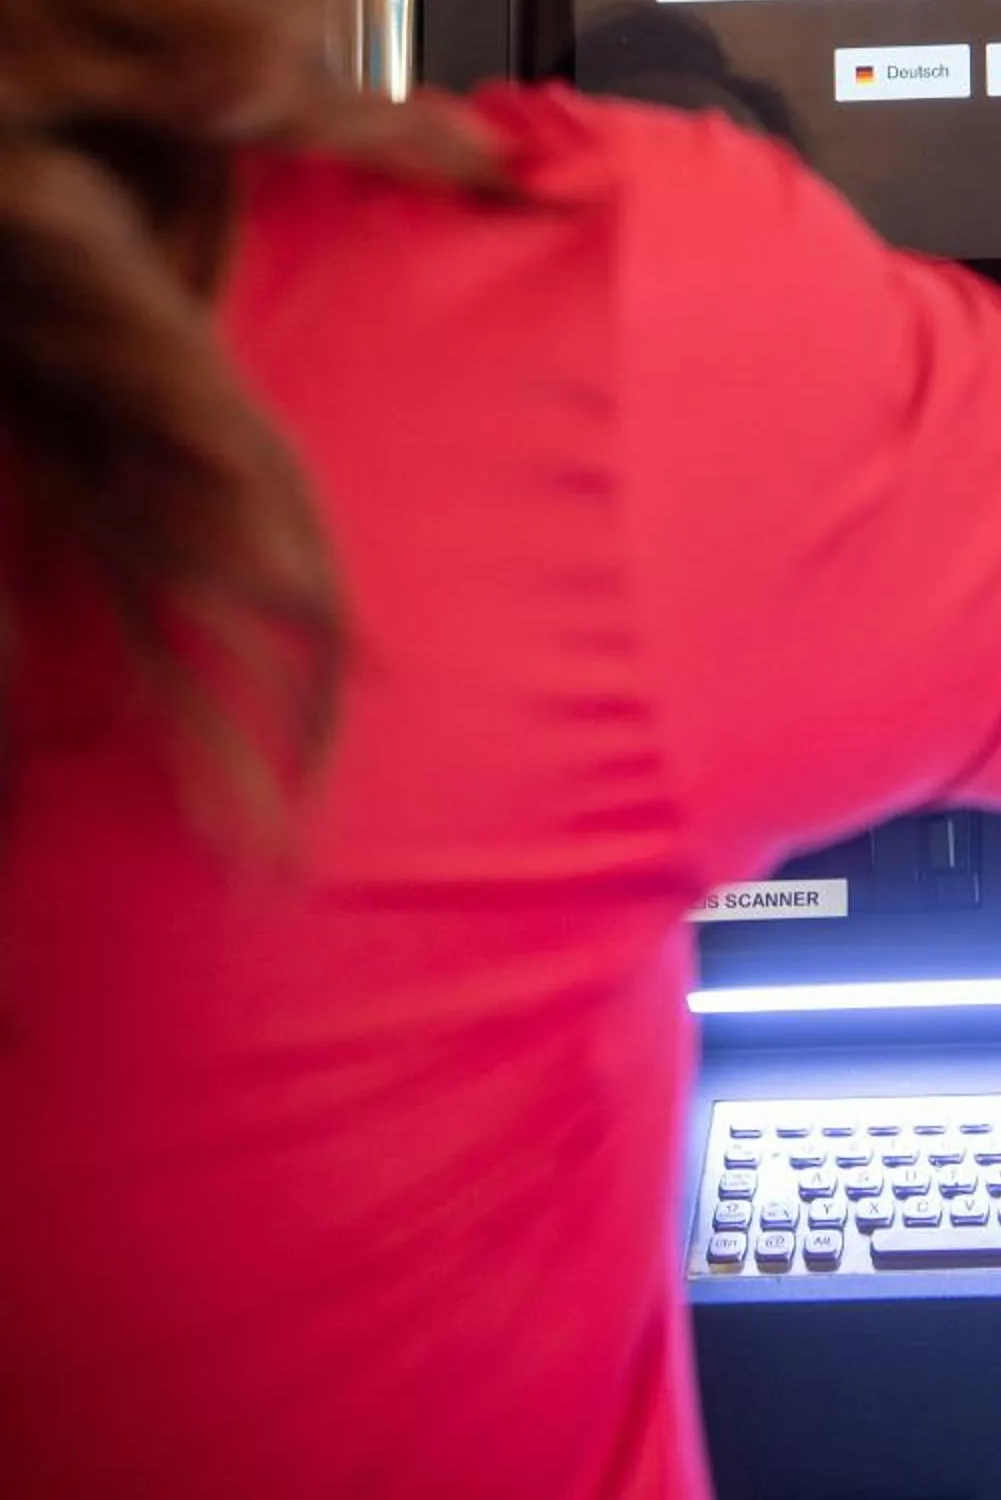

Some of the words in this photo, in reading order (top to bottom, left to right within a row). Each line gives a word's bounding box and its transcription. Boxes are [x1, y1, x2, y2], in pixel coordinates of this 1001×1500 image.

[886, 62, 950, 80] Deutsch
[725, 890, 820, 909] SCANNER
[822, 1202, 833, 1215] Y
[868, 1202, 880, 1214] X
[963, 1200, 976, 1211] V
